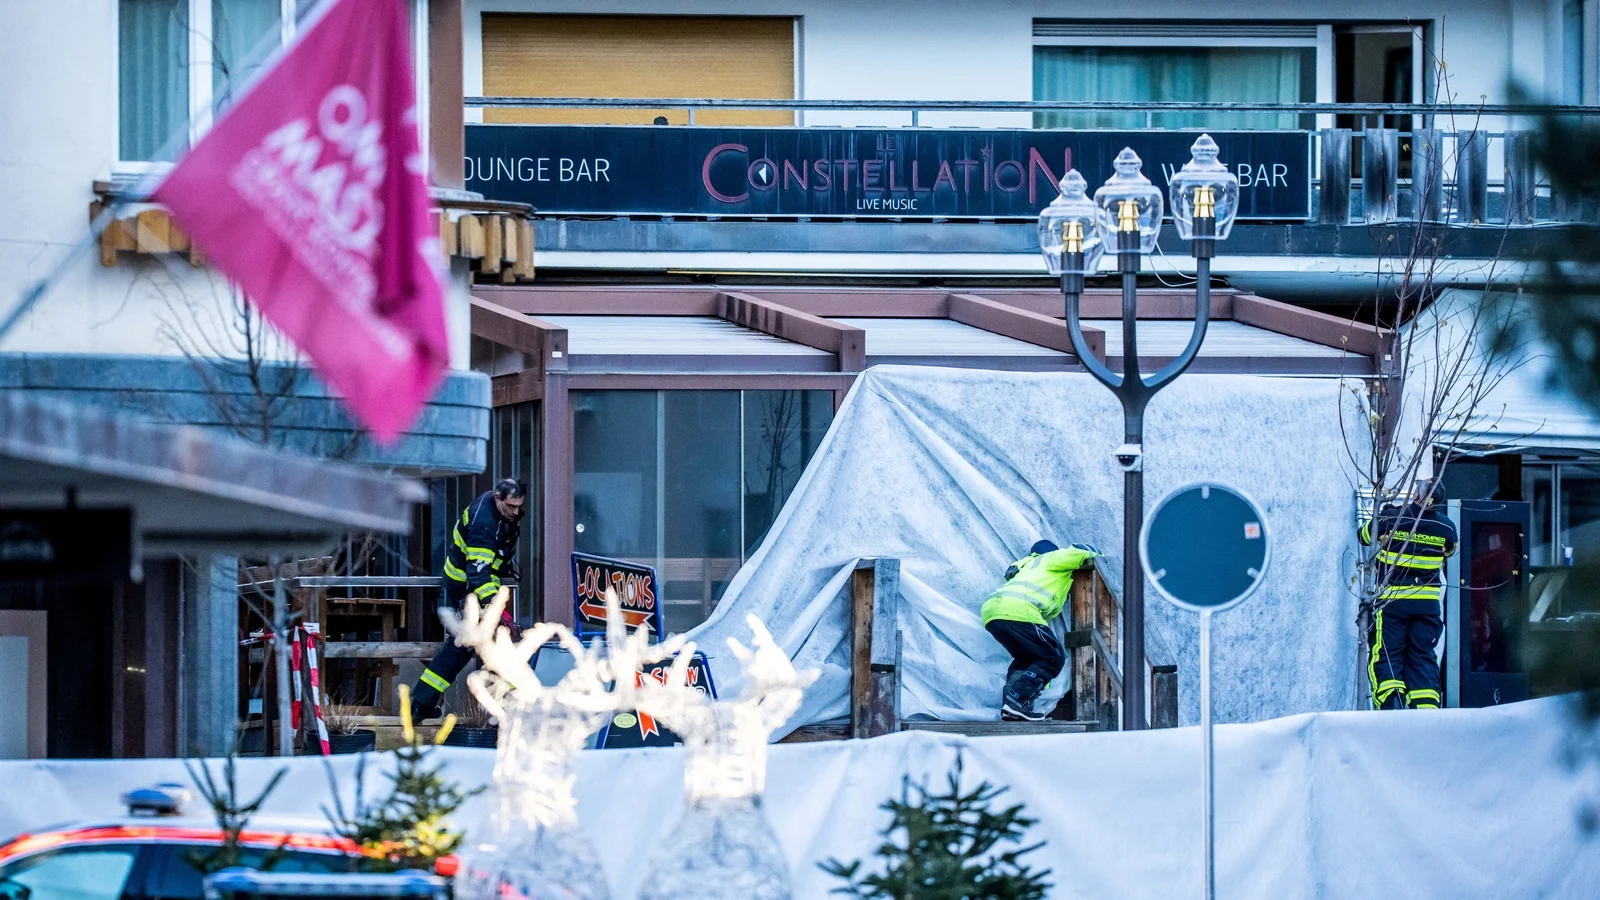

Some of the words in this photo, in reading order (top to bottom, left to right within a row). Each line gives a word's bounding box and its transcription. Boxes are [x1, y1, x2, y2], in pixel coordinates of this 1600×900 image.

[559, 158, 610, 182] BAR
[1237, 163, 1288, 188] BAR
[856, 198, 880, 210] LIVE
[882, 198, 918, 210] MUSIC
